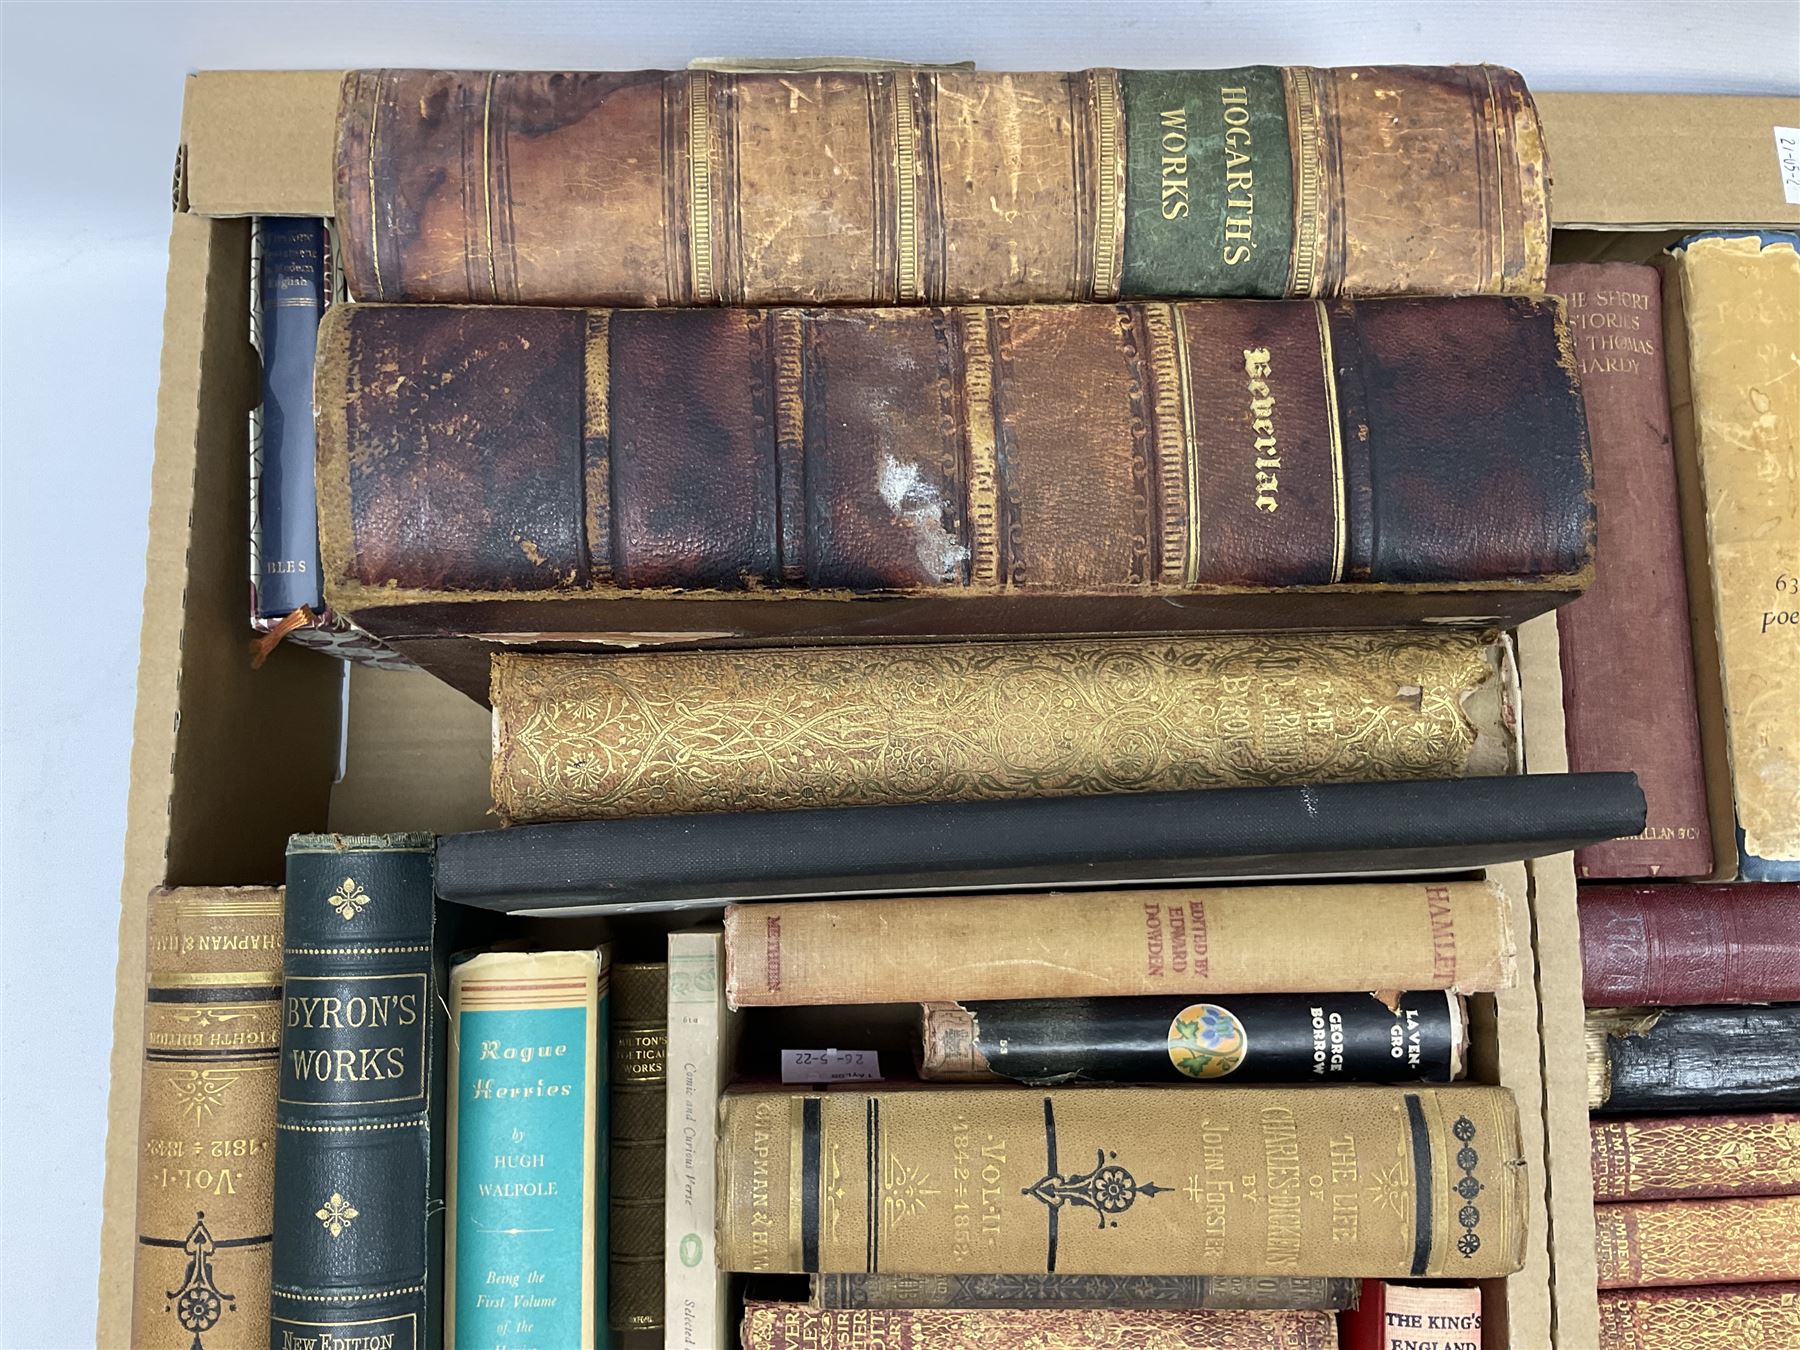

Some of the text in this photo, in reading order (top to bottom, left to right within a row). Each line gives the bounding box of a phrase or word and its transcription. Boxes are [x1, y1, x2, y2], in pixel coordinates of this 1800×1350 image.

[1160, 107, 1189, 220] WORKS
[1221, 86, 1257, 265] HOGARTH'S
[1597, 291, 1650, 310] SHORT
[1586, 336, 1655, 356] THOMAS
[1775, 573, 1799, 595] 63
[1145, 902, 1165, 977] DOWDEN
[1168, 905, 1187, 974] EDWARD
[1425, 886, 1457, 983] HAMLET
[287, 995, 416, 1028] BYRON'S
[480, 1039, 567, 1062] Rogue
[1310, 1007, 1326, 1075] BORROW
[1328, 1012, 1343, 1072] GEORGE
[293, 1048, 404, 1082] WORKS
[624, 1063, 662, 1073] WORKS
[473, 1079, 572, 1099] Herries
[511, 1128, 526, 1144] by
[683, 1062, 697, 1206] Comic and Curious Verse
[1202, 1119, 1229, 1171] JOHN
[210, 1140, 255, 1158] 1812
[494, 1154, 545, 1168] HUGH
[479, 1182, 558, 1197] WALPOLE
[1241, 1174, 1256, 1202] BY
[1309, 1175, 1324, 1200] OF
[1330, 1136, 1359, 1242] THE LIFE
[486, 1270, 545, 1288] Being the
[476, 1294, 557, 1308] First Volume
[516, 1320, 534, 1333] the
[684, 1299, 696, 1345] Selected
[837, 1313, 850, 1345] SIR
[1385, 1312, 1481, 1330] THE KING'S
